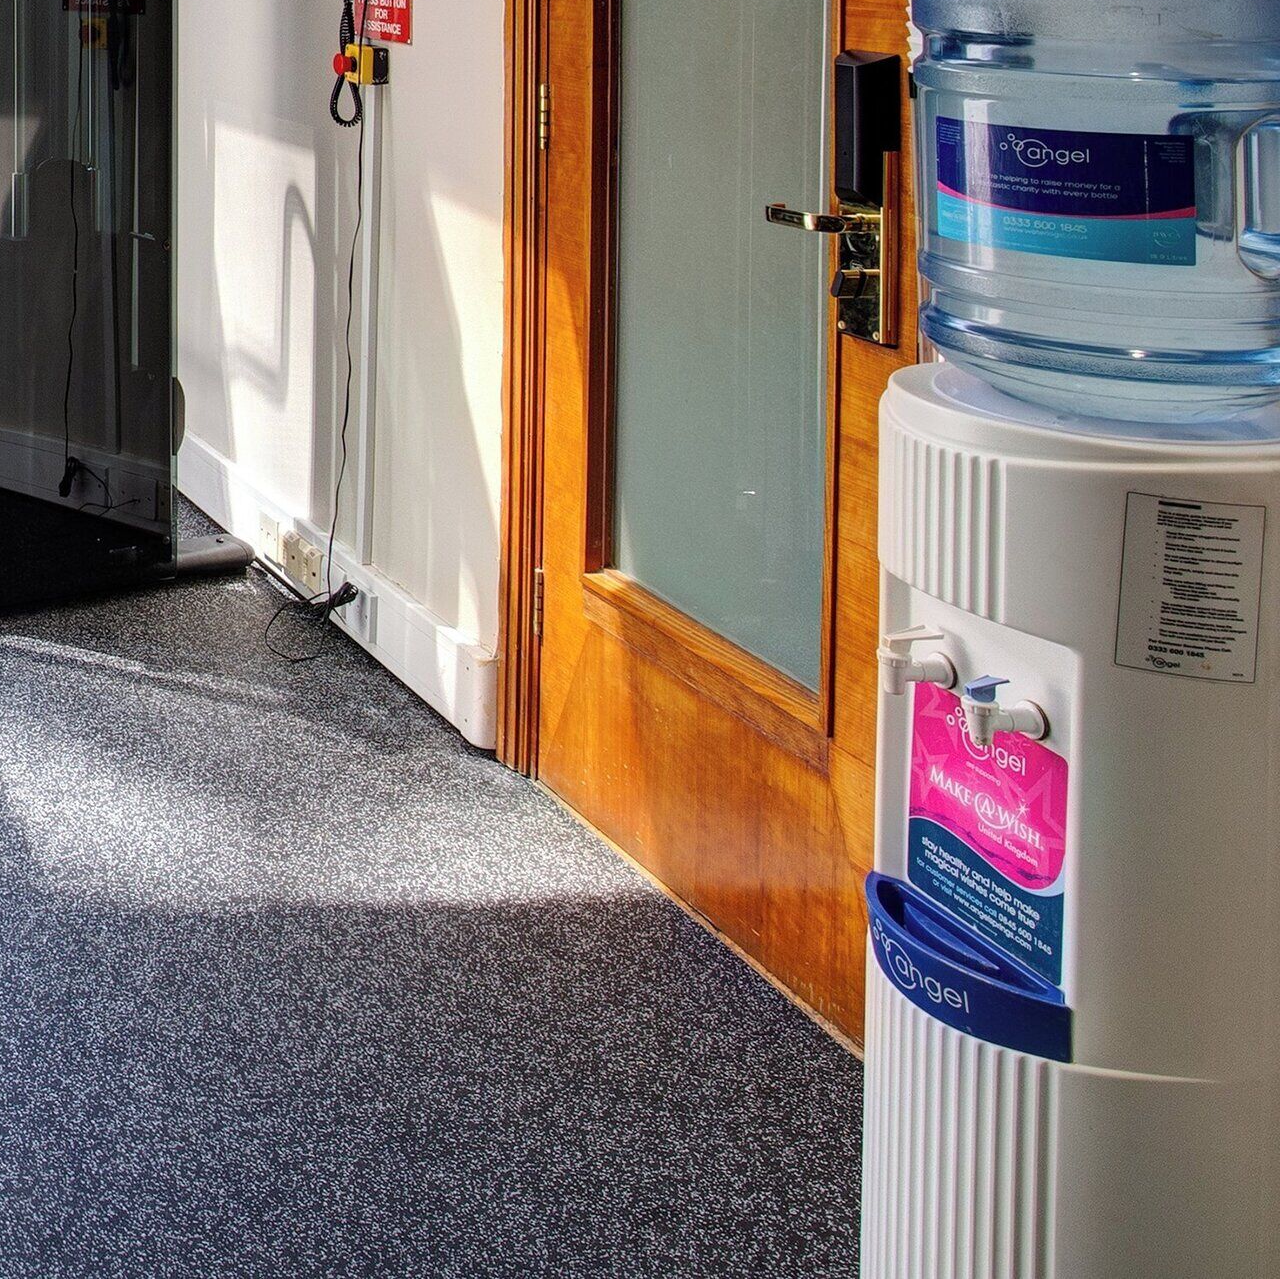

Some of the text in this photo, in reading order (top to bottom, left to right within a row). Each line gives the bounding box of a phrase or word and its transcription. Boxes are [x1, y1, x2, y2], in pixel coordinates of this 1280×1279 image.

[366, 20, 401, 35] SSISTANCE
[375, 8, 389, 20] FOR
[1020, 143, 1089, 166] angel
[1000, 174, 1029, 185] helping
[1065, 181, 1098, 190] money
[1100, 183, 1112, 191] for
[1011, 184, 1040, 194] charity
[1042, 187, 1061, 195] with
[1063, 190, 1089, 199] every
[1091, 191, 1118, 199] bottle
[1003, 216, 1088, 233] 0333 600 1845
[978, 823, 1038, 867] United Kingdom
[921, 836, 1040, 921] stay healthy and help make
[924, 849, 959, 878] magical
[960, 872, 989, 898] wishes
[989, 893, 1017, 916] come
[925, 864, 955, 888] customer
[956, 883, 983, 908] services
[984, 902, 997, 918] call
[998, 913, 1017, 931] 0845
[1018, 927, 1032, 941] 600
[1034, 936, 1052, 955] 1845
[940, 883, 953, 897] visit
[953, 892, 1032, 951] www.angelsprings.com
[888, 943, 970, 1014] angel
